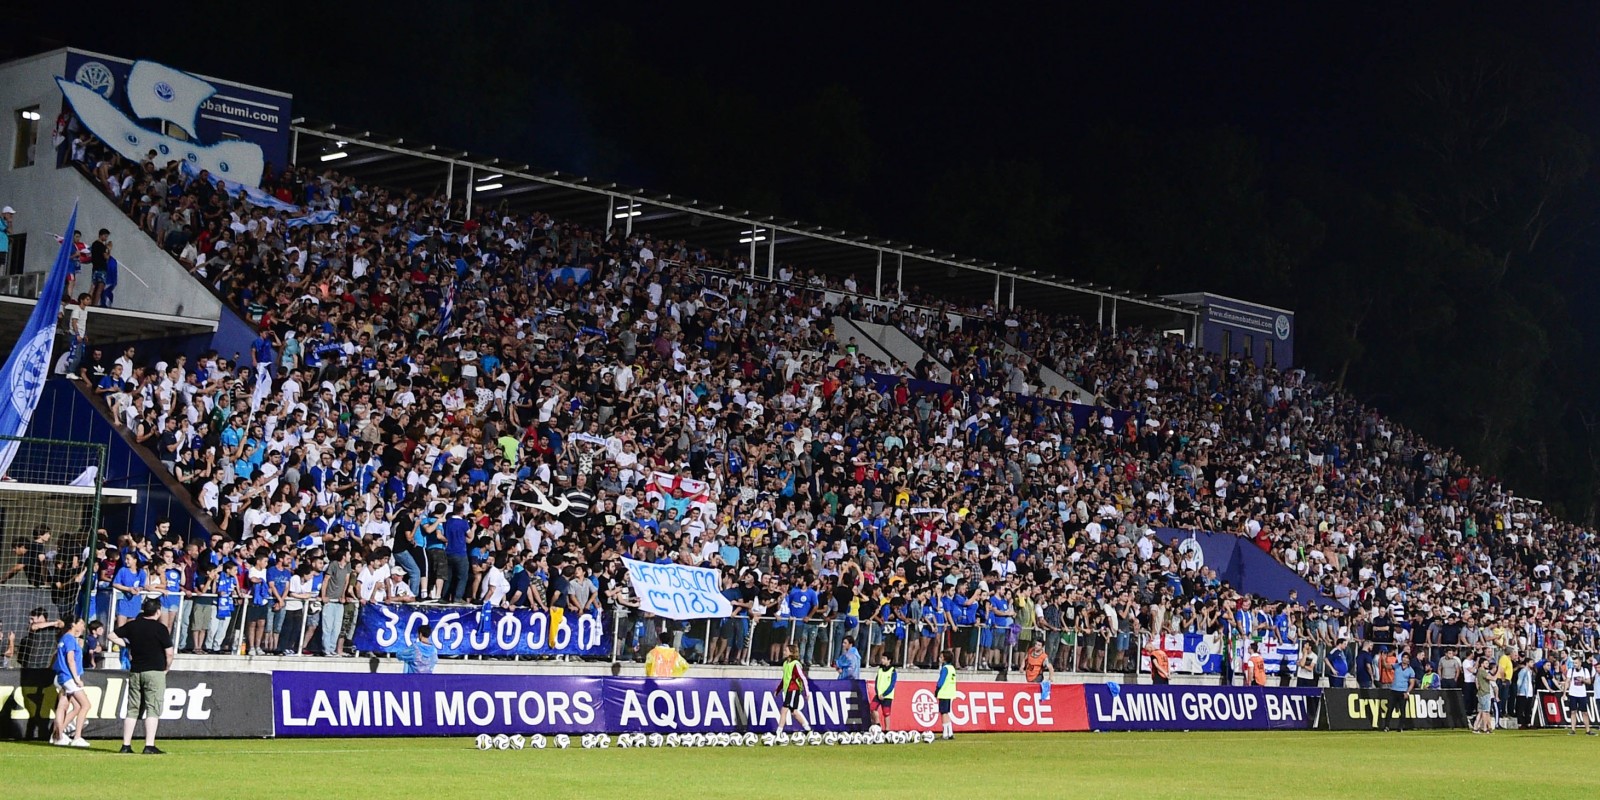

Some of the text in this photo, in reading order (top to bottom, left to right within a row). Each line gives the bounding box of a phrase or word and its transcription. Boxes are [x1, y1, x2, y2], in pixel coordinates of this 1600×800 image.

[648, 588, 720, 614] ლიგა
[281, 688, 595, 727] LAMINI MOTORS
[949, 691, 1054, 726] GFF.GE
[1094, 692, 1177, 722] LAMINI
[1181, 692, 1258, 721] GROUP
